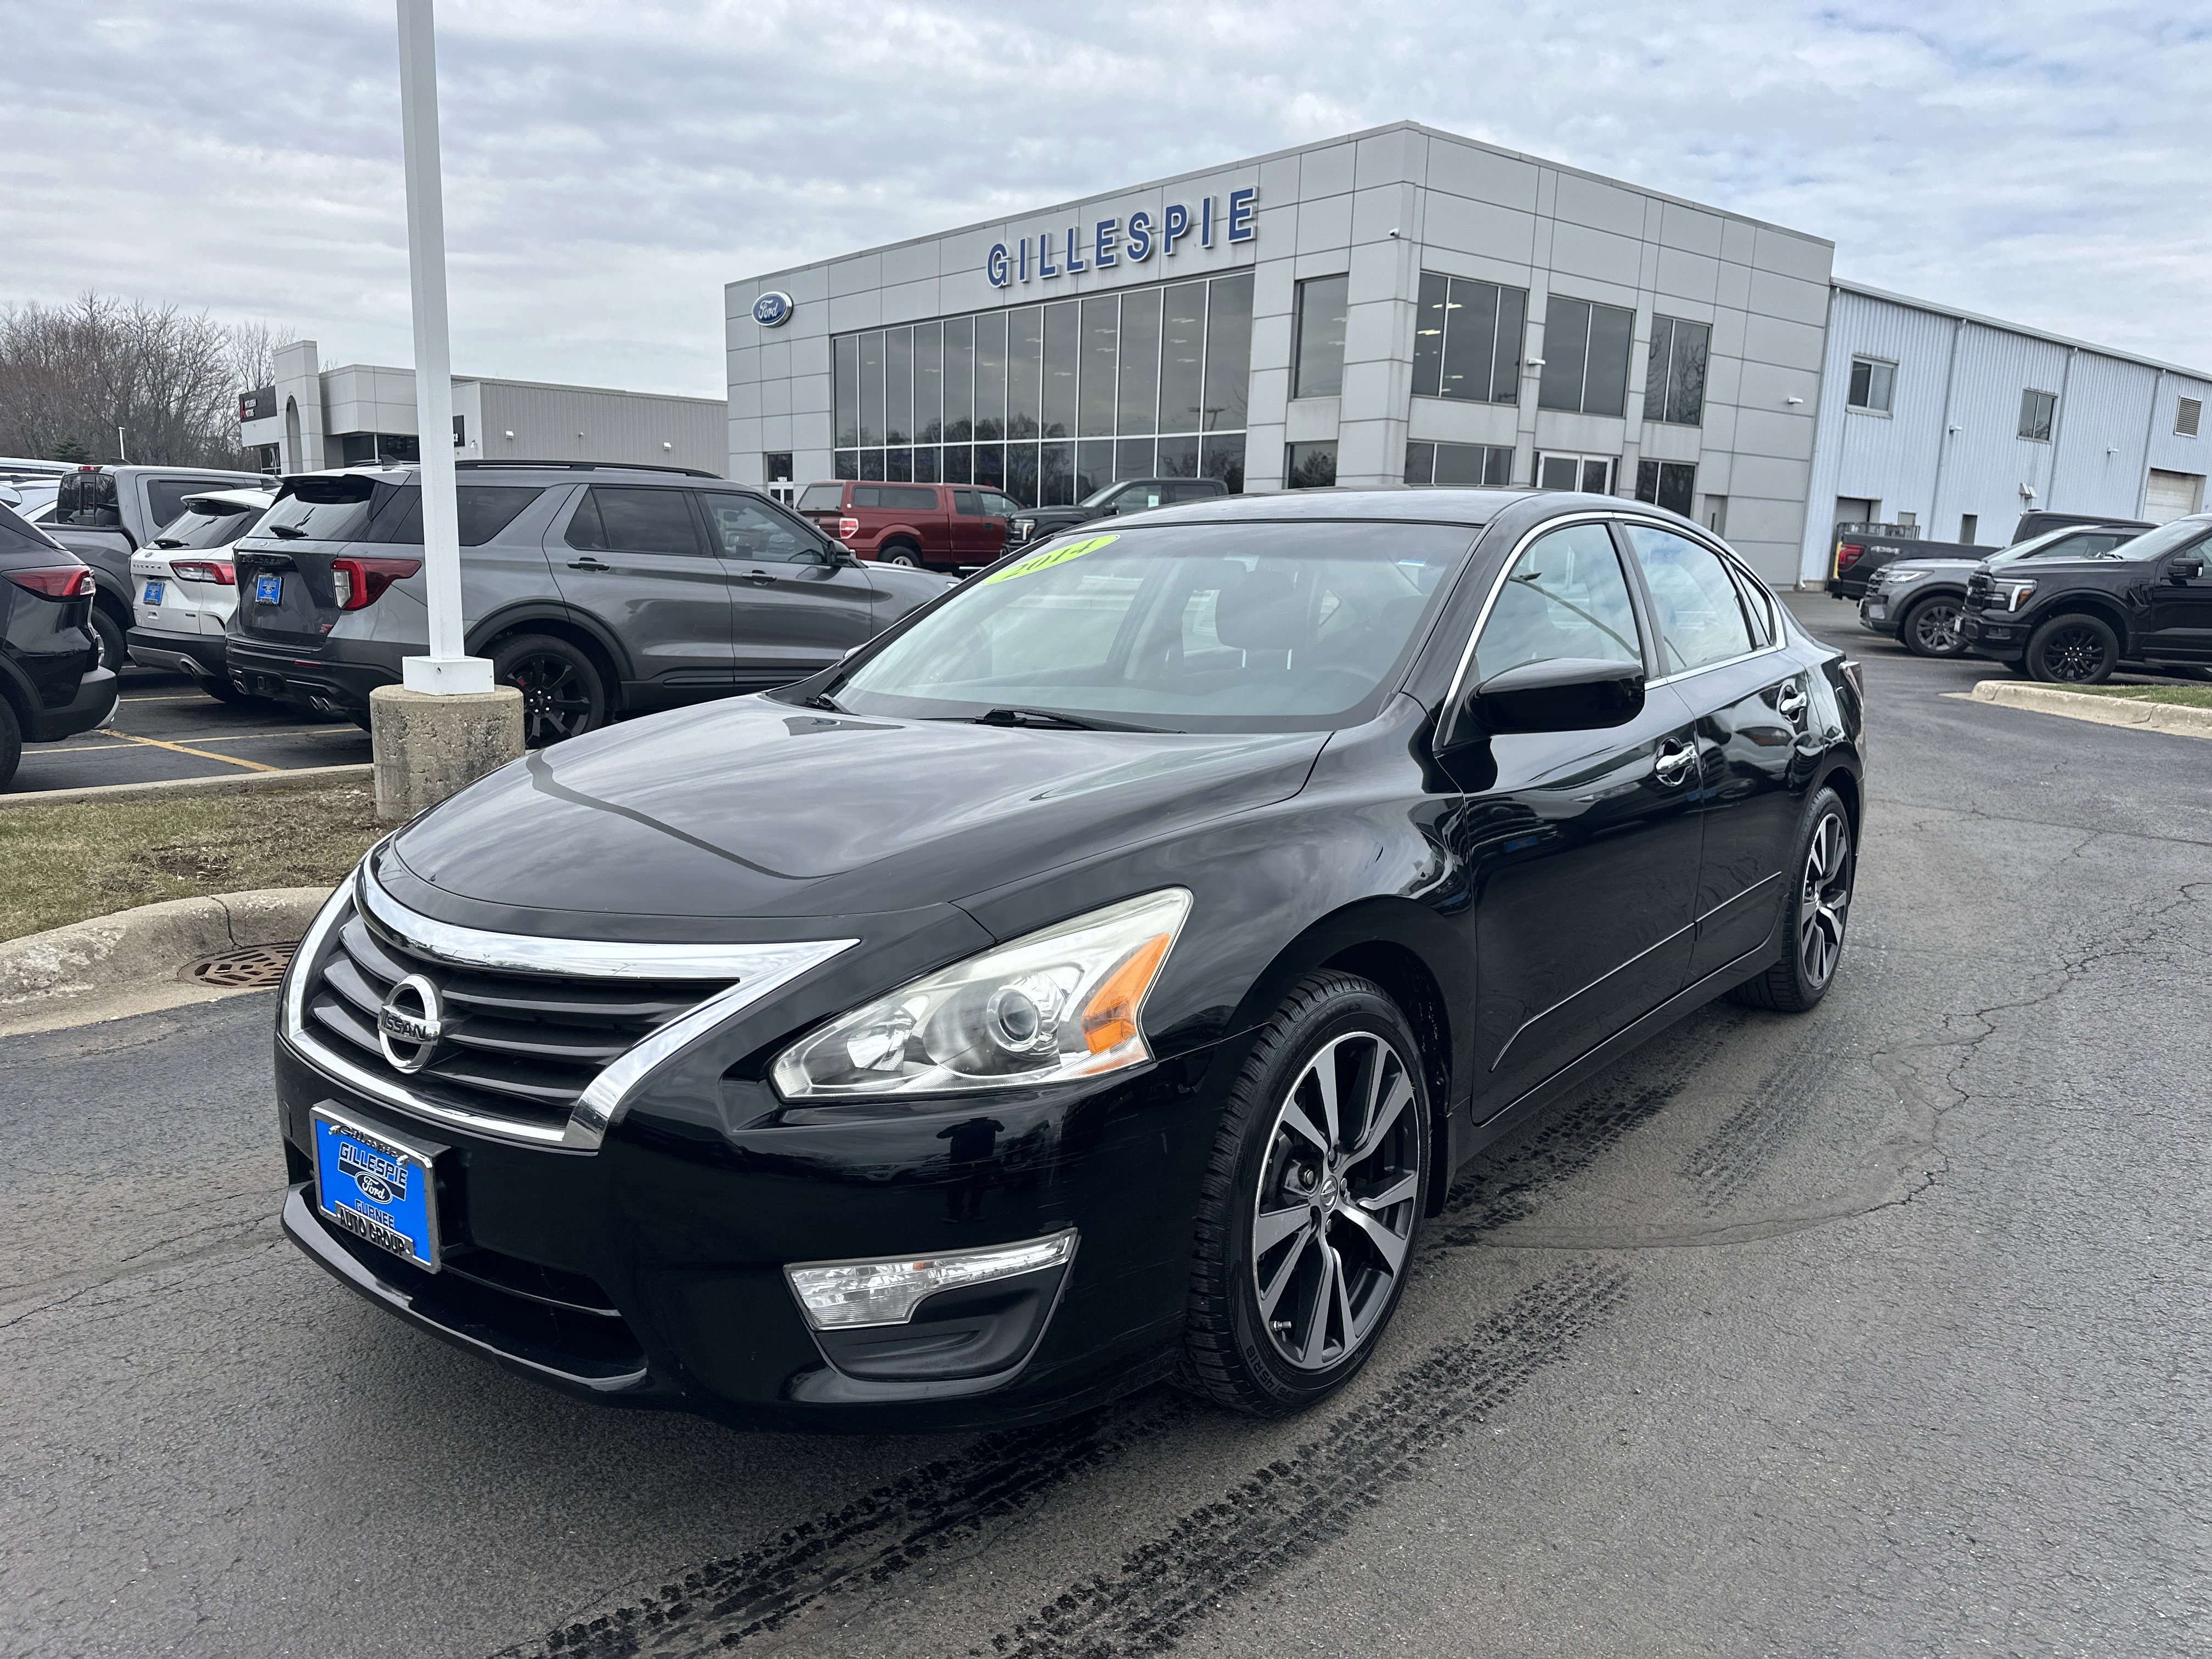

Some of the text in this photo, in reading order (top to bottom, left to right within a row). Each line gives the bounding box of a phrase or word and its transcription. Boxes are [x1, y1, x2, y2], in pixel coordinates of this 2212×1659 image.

[986, 186, 1259, 288] GILLESPIE
[758, 299, 778, 319] Ford
[1001, 539, 1098, 580] 2014
[340, 1125, 399, 1159] Gillespie
[339, 1141, 408, 1188] GILLESPIE
[362, 1176, 385, 1200] Ford
[340, 1207, 405, 1256] AUTO GROUP
[355, 1198, 395, 1229] GURNEE
